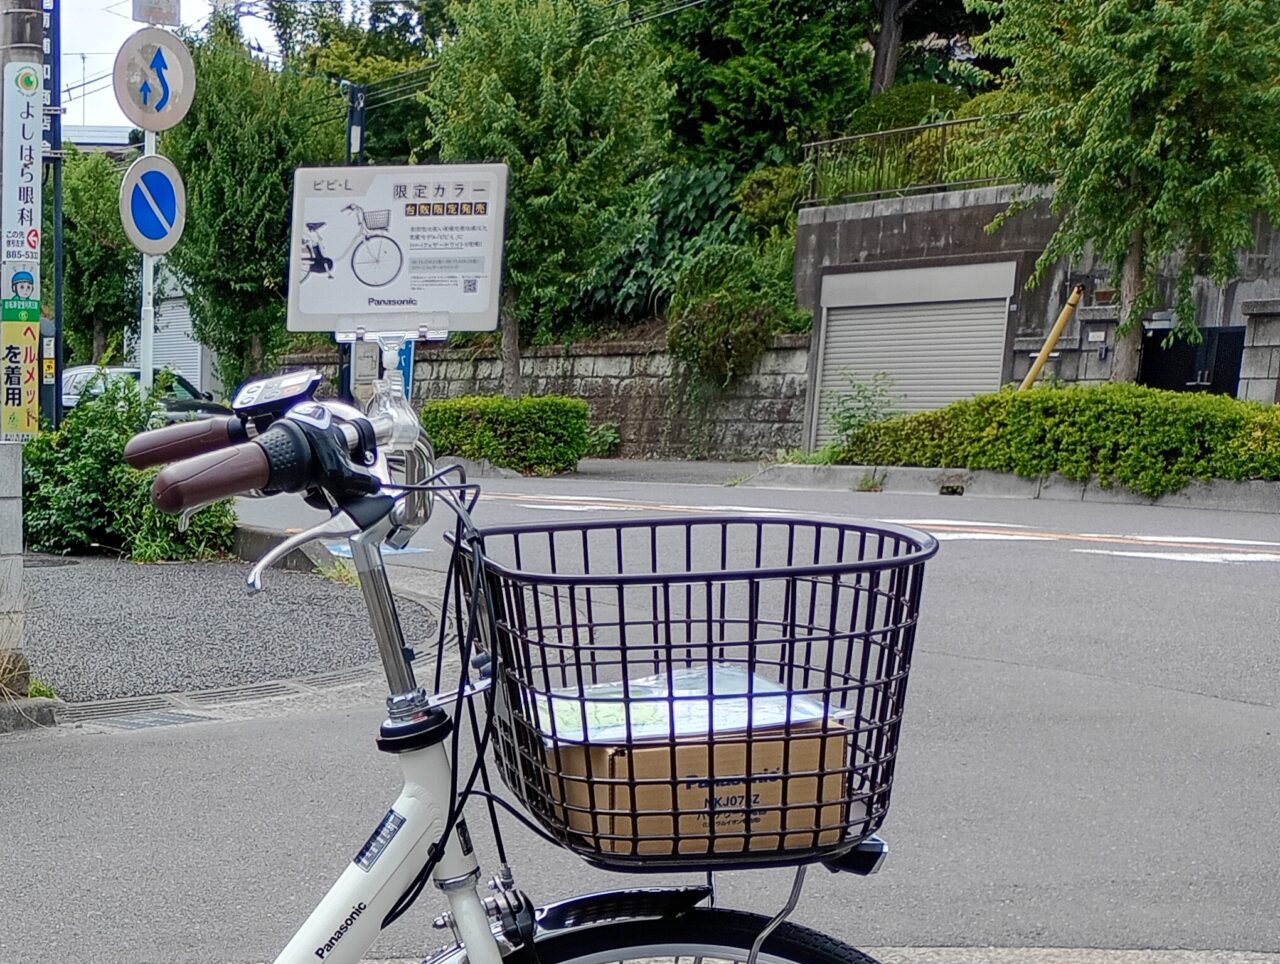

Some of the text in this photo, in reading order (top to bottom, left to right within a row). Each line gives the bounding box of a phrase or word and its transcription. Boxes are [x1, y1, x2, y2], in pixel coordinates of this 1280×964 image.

[17, 101, 35, 226] よしはら眼科
[394, 184, 486, 199] 限定カラー
[406, 203, 487, 216] 台数限定発売
[6, 231, 25, 239] この先
[367, 297, 418, 307] Panasonic
[4, 345, 22, 407] を着用
[23, 326, 37, 427] ヘルメット
[704, 794, 760, 809] NKJ07Z
[314, 902, 368, 960] Panasonic
